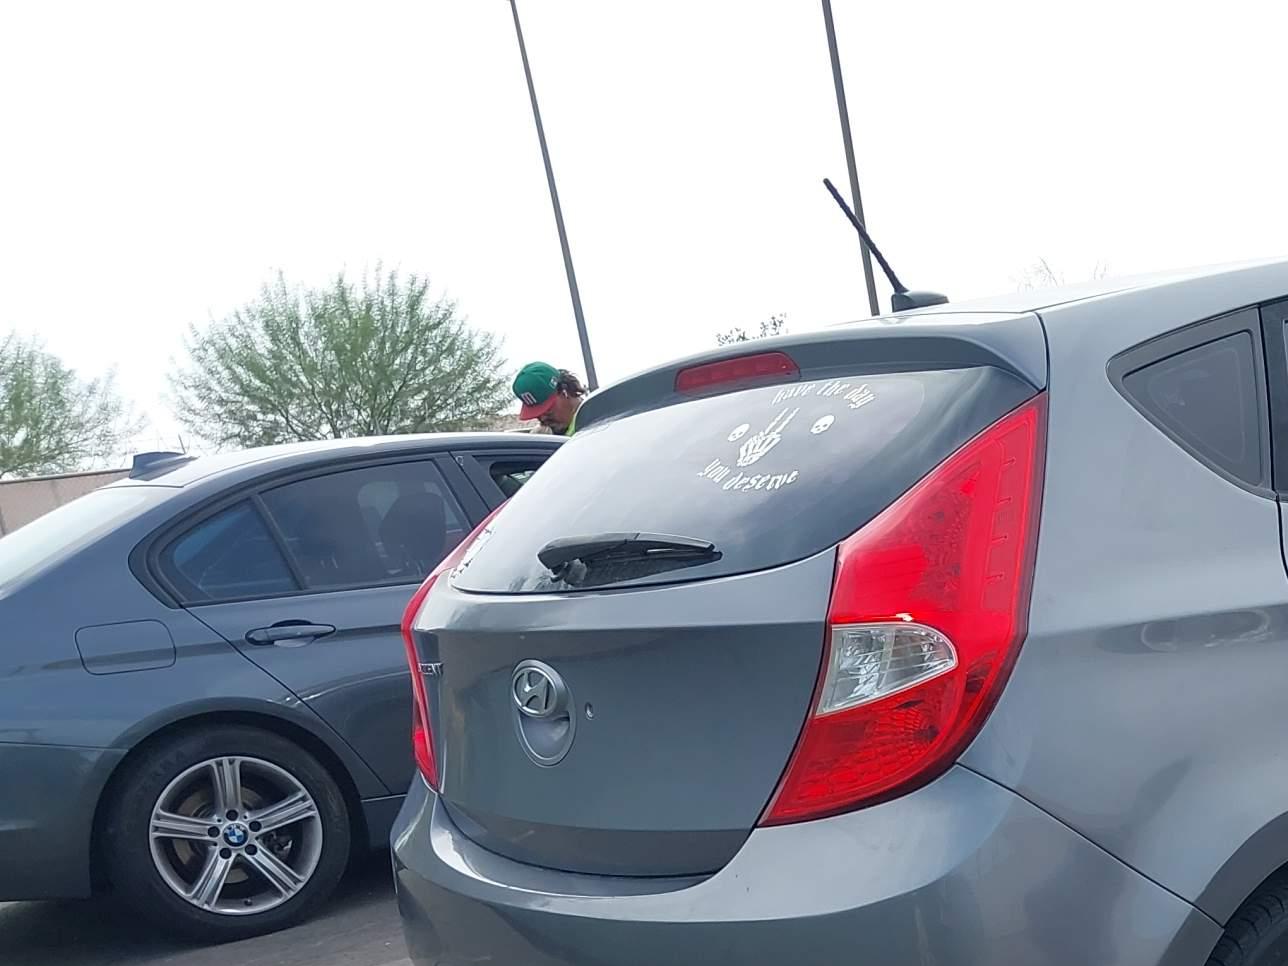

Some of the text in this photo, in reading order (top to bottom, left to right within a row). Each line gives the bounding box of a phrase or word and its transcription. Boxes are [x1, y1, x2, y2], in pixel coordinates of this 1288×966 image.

[771, 381, 876, 409] have the day
[697, 458, 800, 492] you deserve
